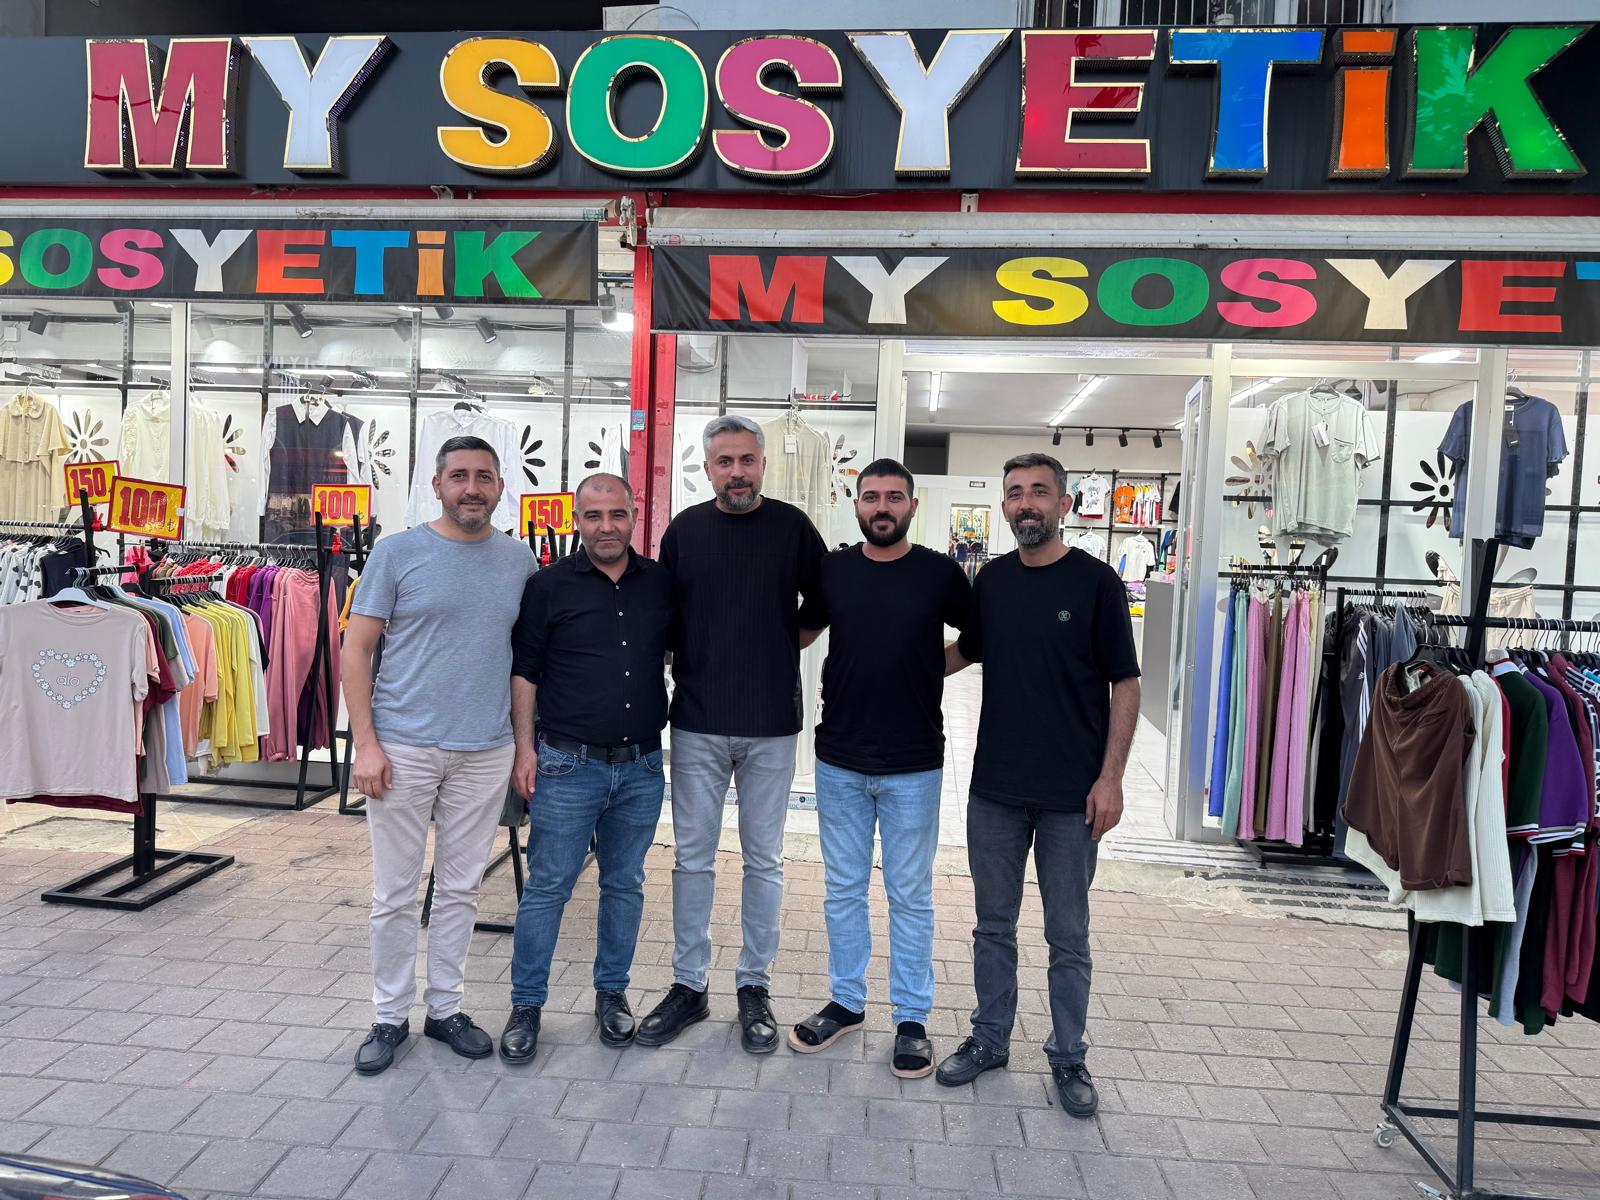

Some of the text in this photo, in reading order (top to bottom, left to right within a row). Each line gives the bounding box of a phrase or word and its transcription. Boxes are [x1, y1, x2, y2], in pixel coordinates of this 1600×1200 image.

[84, 36, 389, 171] MY
[709, 255, 1600, 333] MY SOSYE
[69, 467, 107, 498] 150
[119, 486, 167, 528] 100
[318, 490, 356, 520] 100
[528, 499, 563, 529] 150
